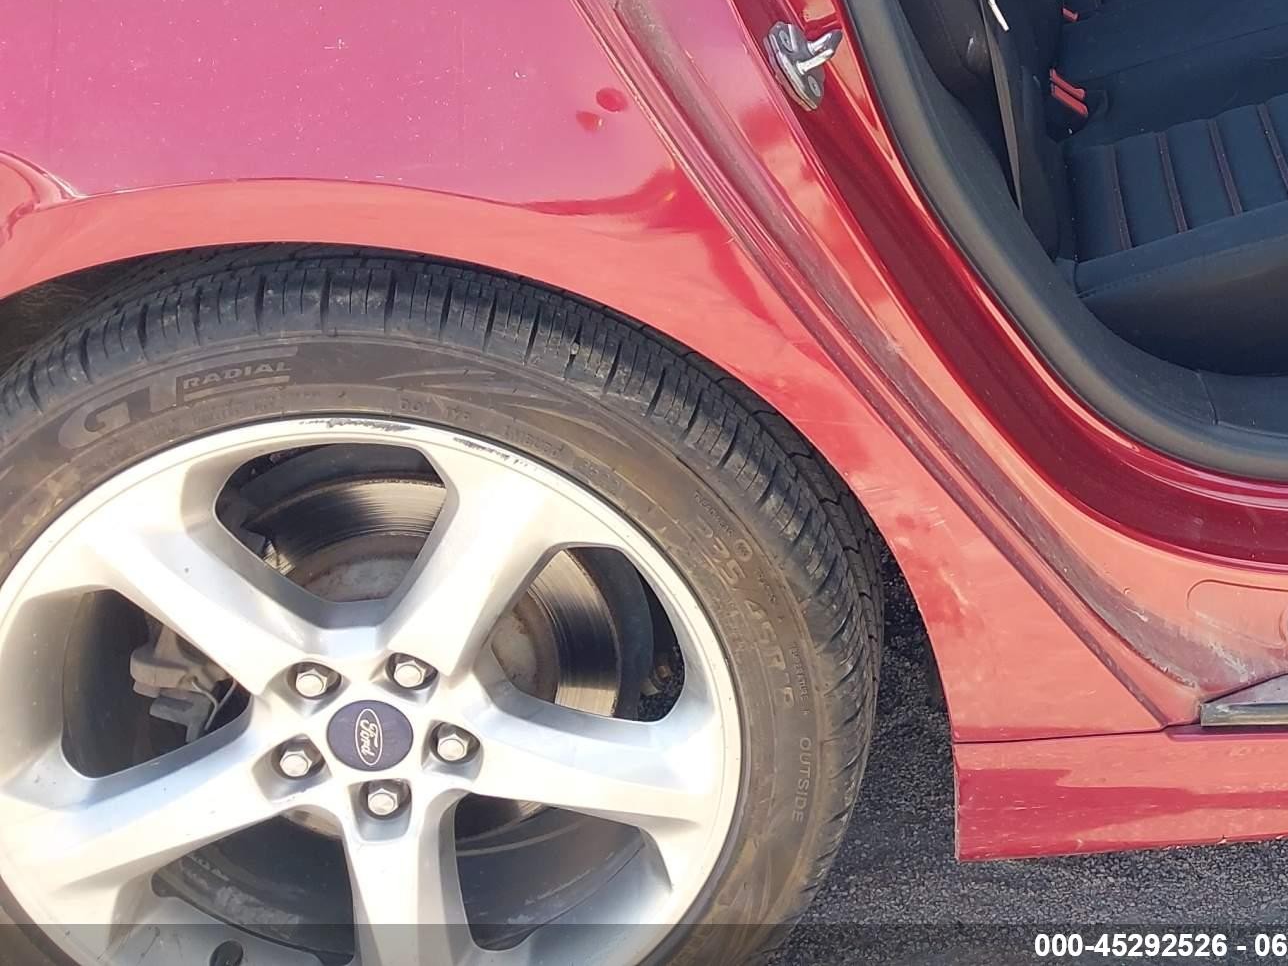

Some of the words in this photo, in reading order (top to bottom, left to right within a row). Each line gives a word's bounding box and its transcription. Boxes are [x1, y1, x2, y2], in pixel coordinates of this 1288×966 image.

[182, 361, 292, 389] RADIAL
[359, 719, 379, 756] Ford
[791, 737, 812, 822] OUTSIDE
